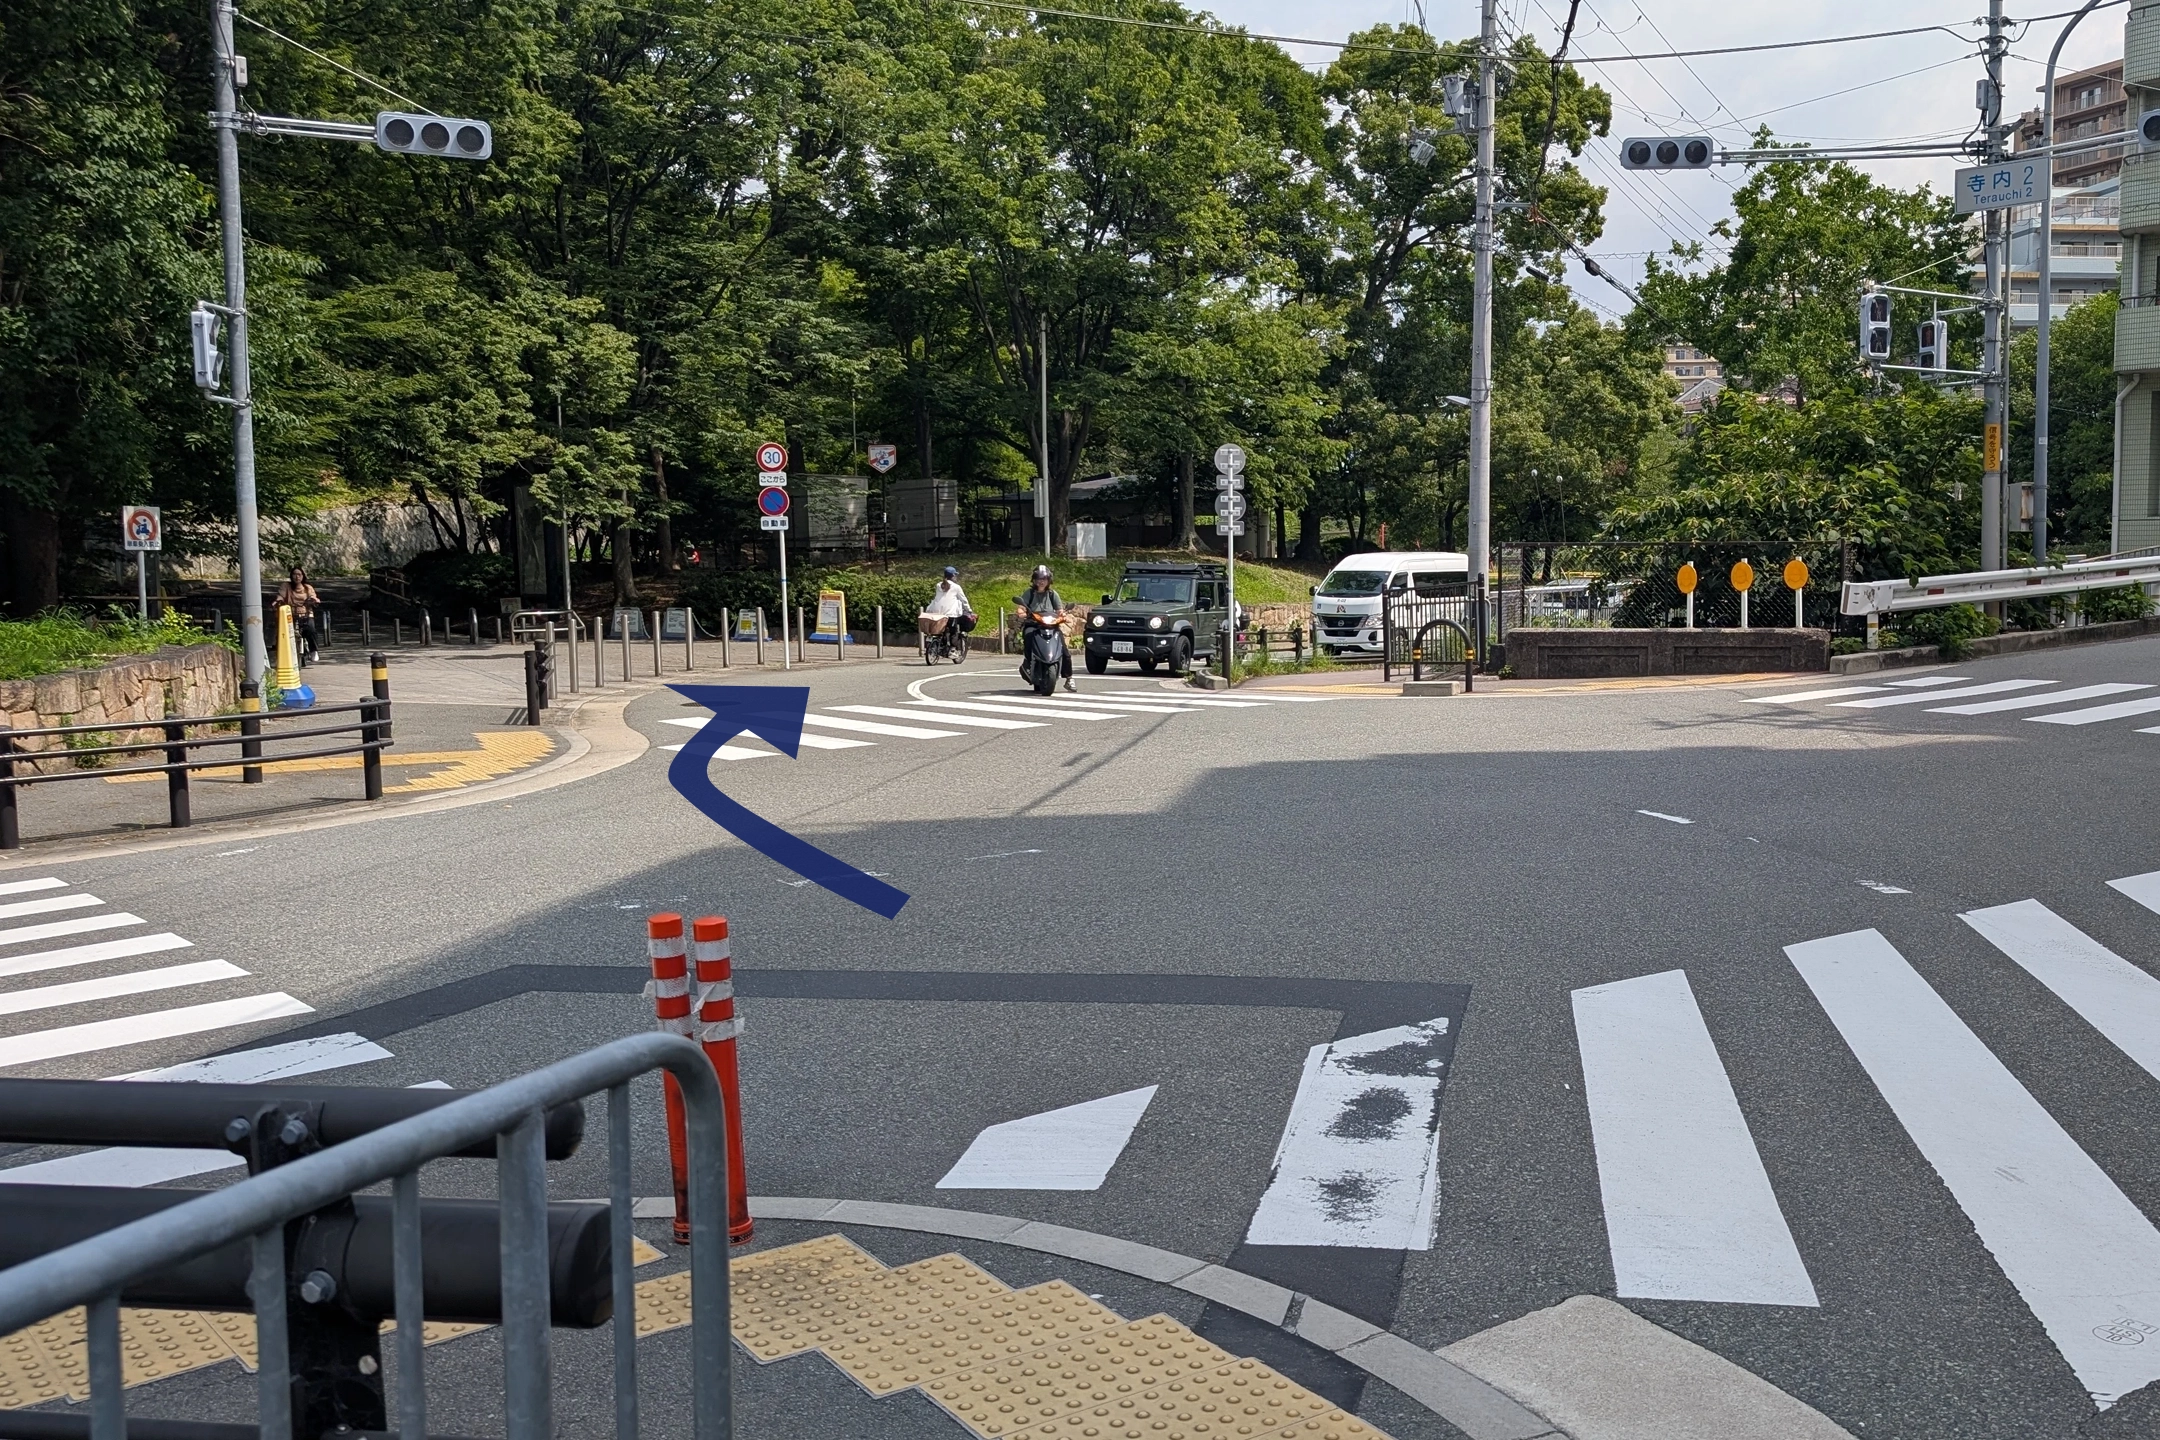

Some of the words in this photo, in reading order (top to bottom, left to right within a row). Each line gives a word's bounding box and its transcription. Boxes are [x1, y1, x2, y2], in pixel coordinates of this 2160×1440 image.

[1967, 170, 2011, 193] 寺内
[2023, 165, 2034, 185] 2
[1973, 188, 2022, 205] Terauchi
[2026, 187, 2033, 198] 2
[764, 451, 781, 464] 30
[762, 519, 787, 528] 自動車
